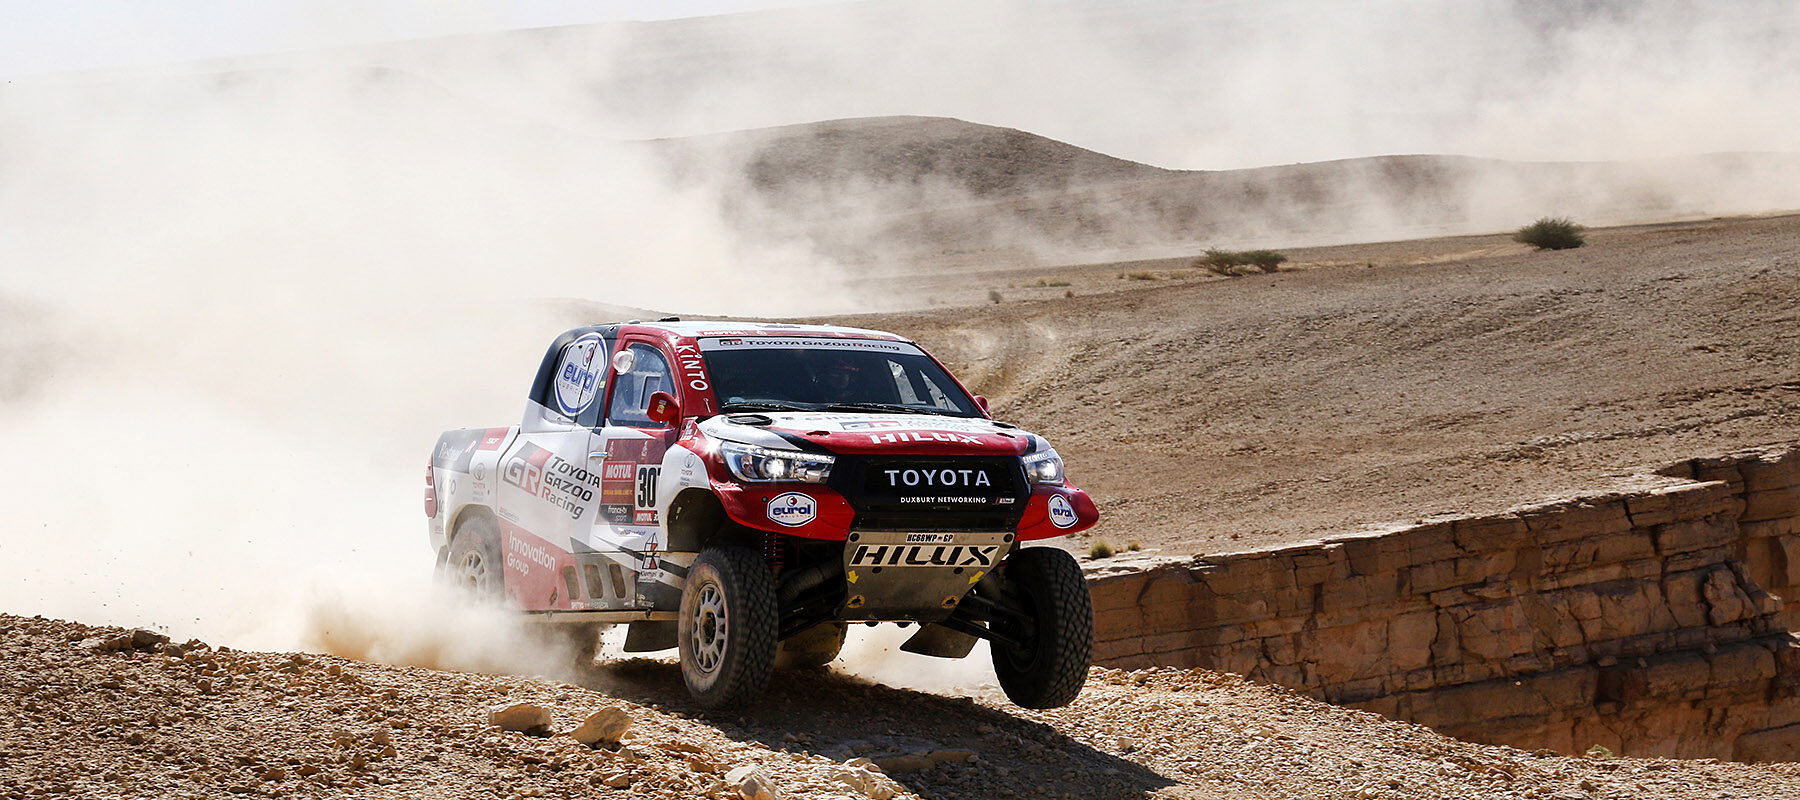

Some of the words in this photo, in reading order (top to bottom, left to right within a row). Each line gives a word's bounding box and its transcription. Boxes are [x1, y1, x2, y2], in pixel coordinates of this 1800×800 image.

[853, 342, 900, 351] Racing
[563, 362, 600, 394] eurol
[869, 432, 984, 446] HILUX
[505, 456, 540, 496] GR
[551, 456, 601, 488] TOYOTA
[605, 464, 632, 478] MOTUL
[884, 469, 990, 486] TOYOTA
[545, 471, 593, 502] GAZOO
[541, 486, 584, 520] Racing
[773, 504, 811, 515] eurol
[1052, 508, 1073, 518] eurol
[509, 531, 556, 572] Innovation
[851, 545, 998, 566] HILUX
[507, 552, 529, 577] Group
